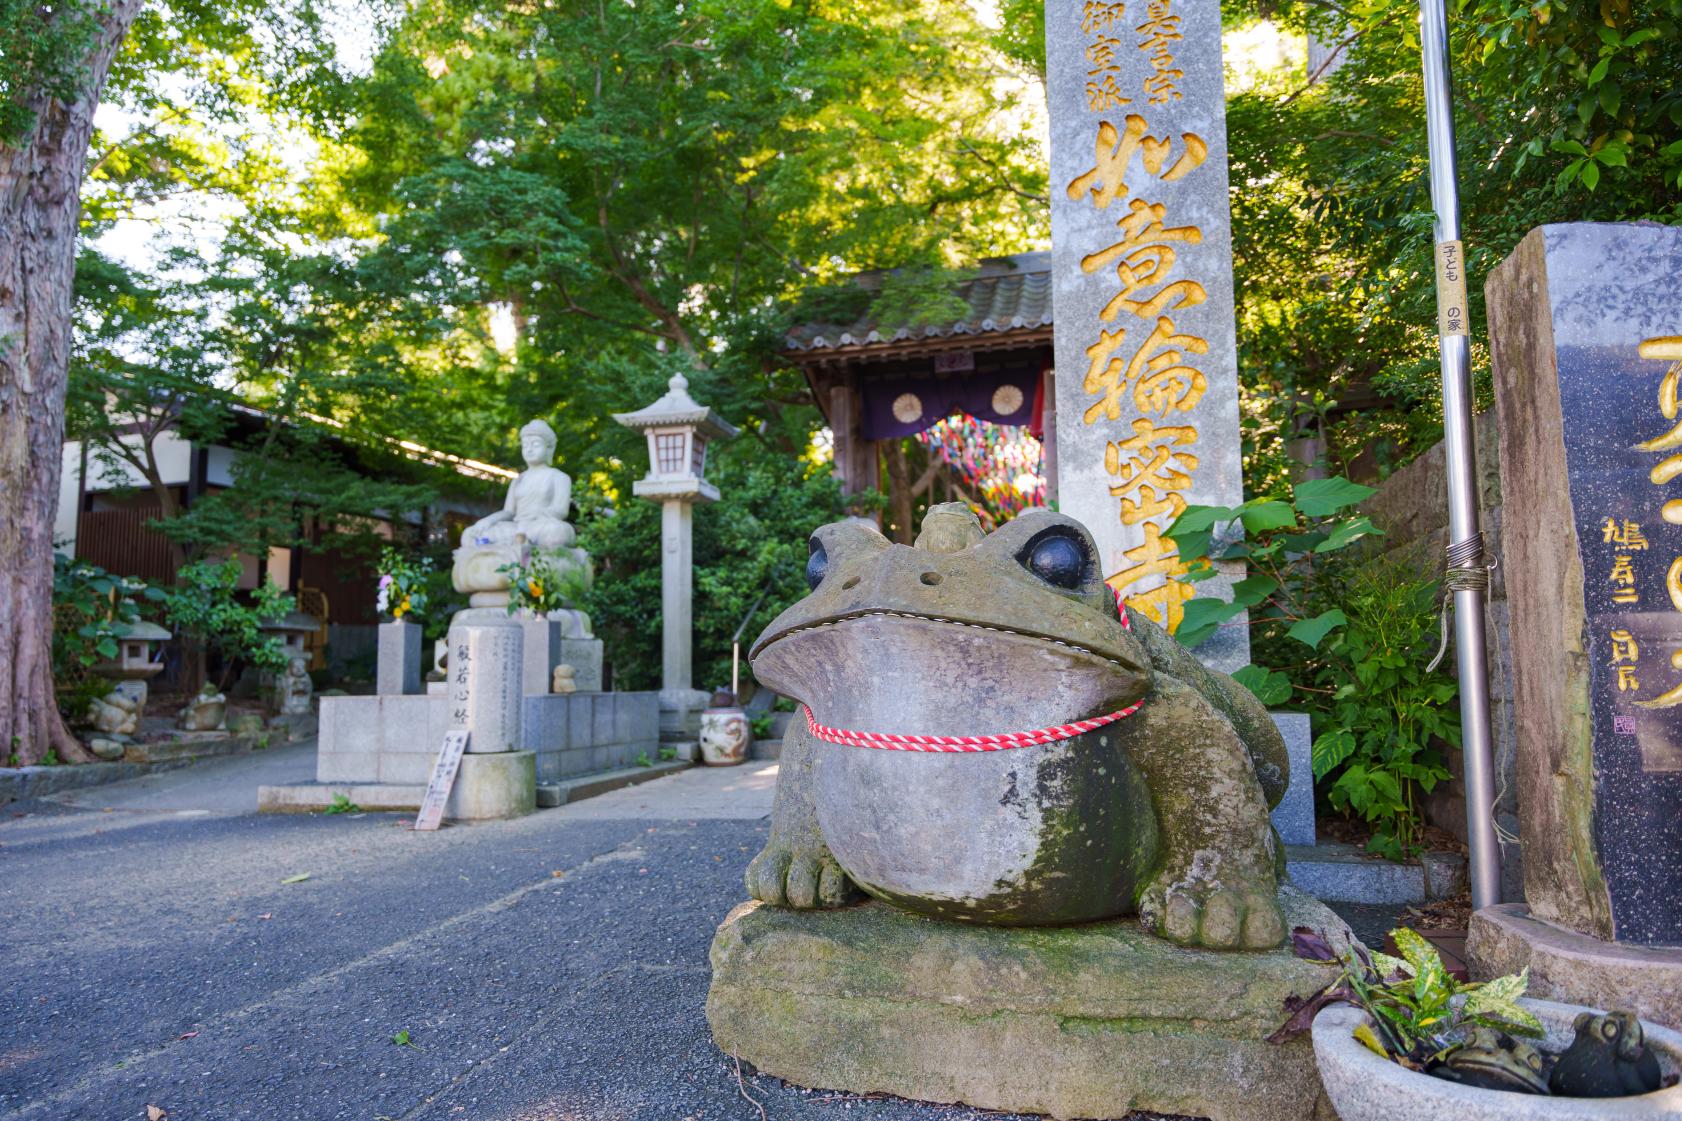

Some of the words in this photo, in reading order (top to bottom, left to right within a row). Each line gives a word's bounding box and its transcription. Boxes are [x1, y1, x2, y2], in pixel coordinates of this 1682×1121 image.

[1080, 0, 1133, 113] 御室派
[1443, 245, 1457, 282] 子ども
[1447, 306, 1461, 331] の家
